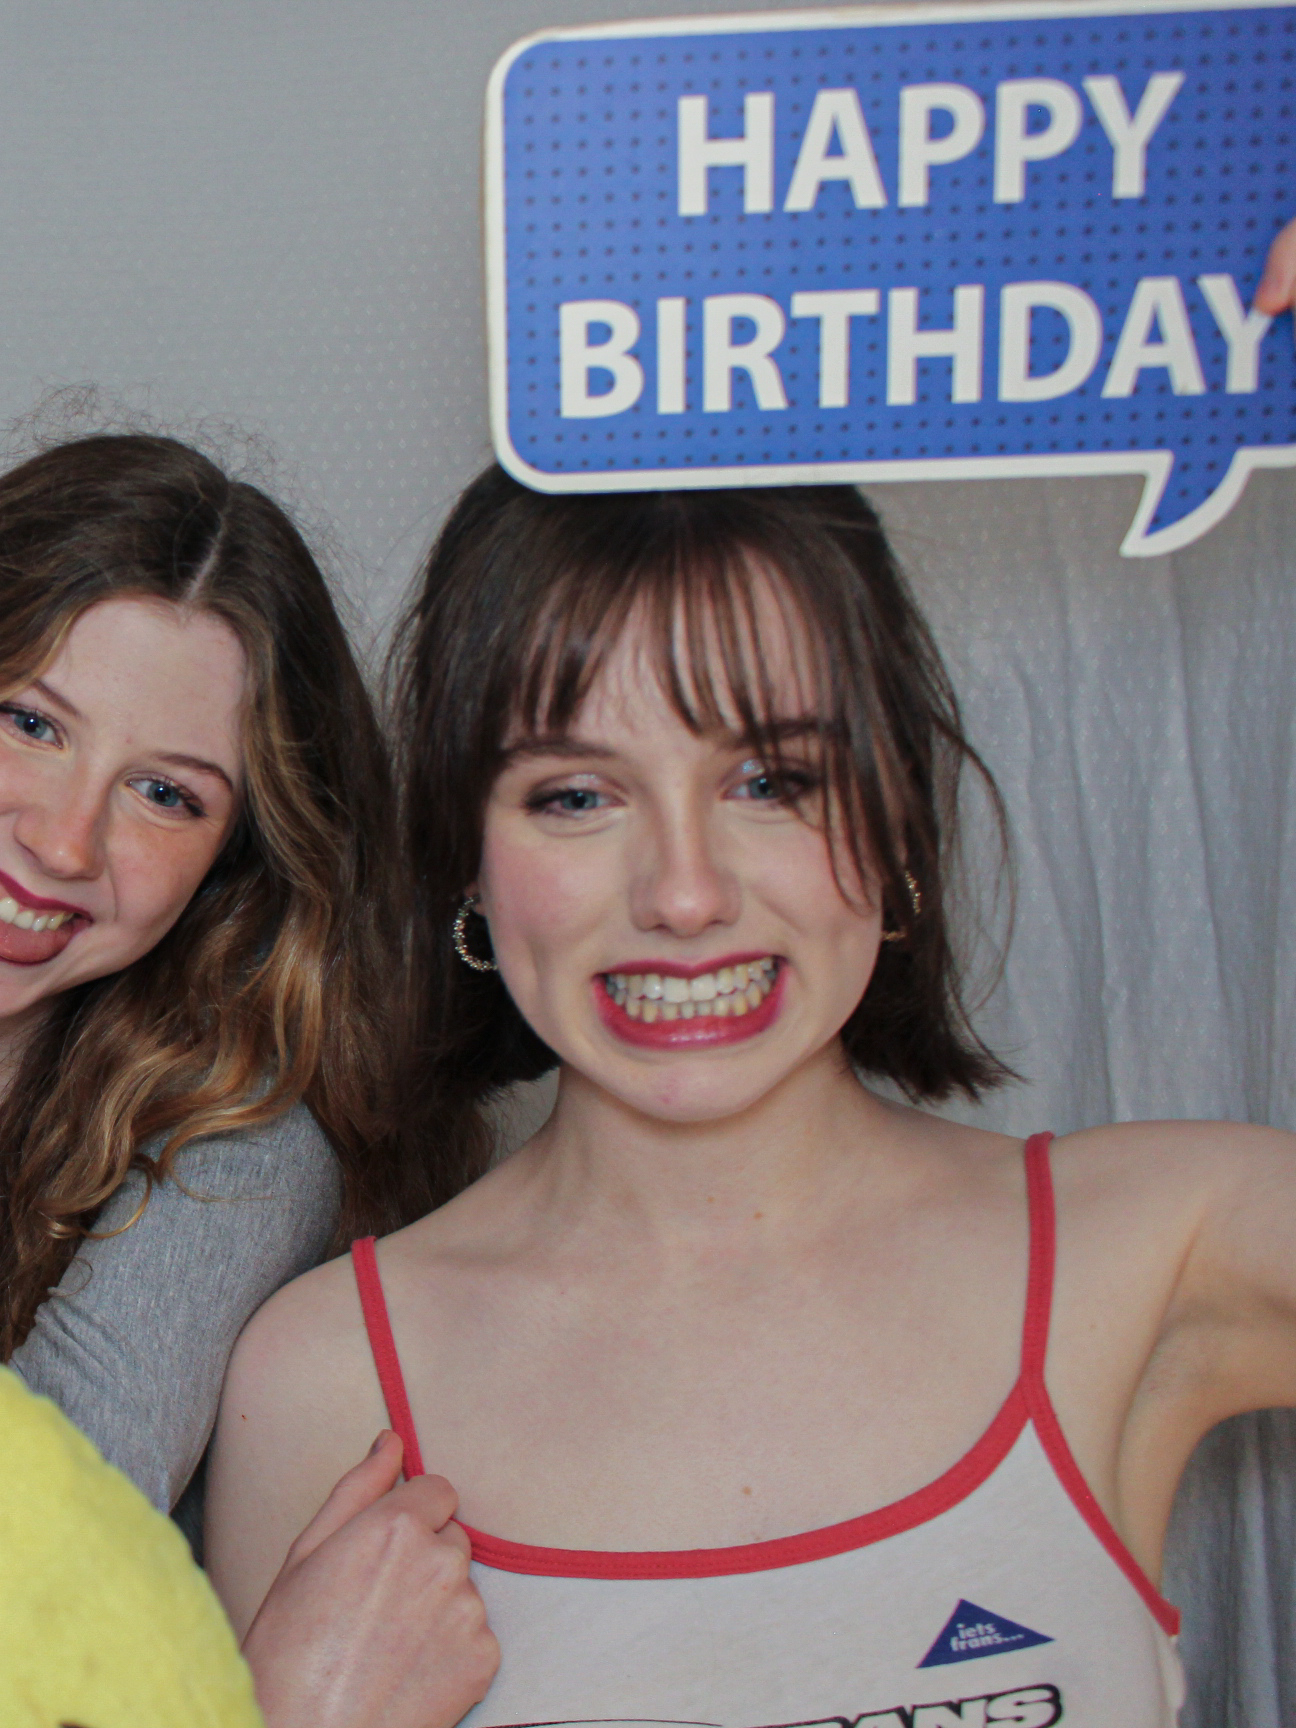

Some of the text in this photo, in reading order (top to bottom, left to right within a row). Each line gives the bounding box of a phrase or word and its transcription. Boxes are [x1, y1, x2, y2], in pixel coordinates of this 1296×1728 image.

[678, 70, 1185, 216] HAPPY
[559, 273, 1275, 419] BIRTHDAY
[956, 1622, 997, 1640] iets
